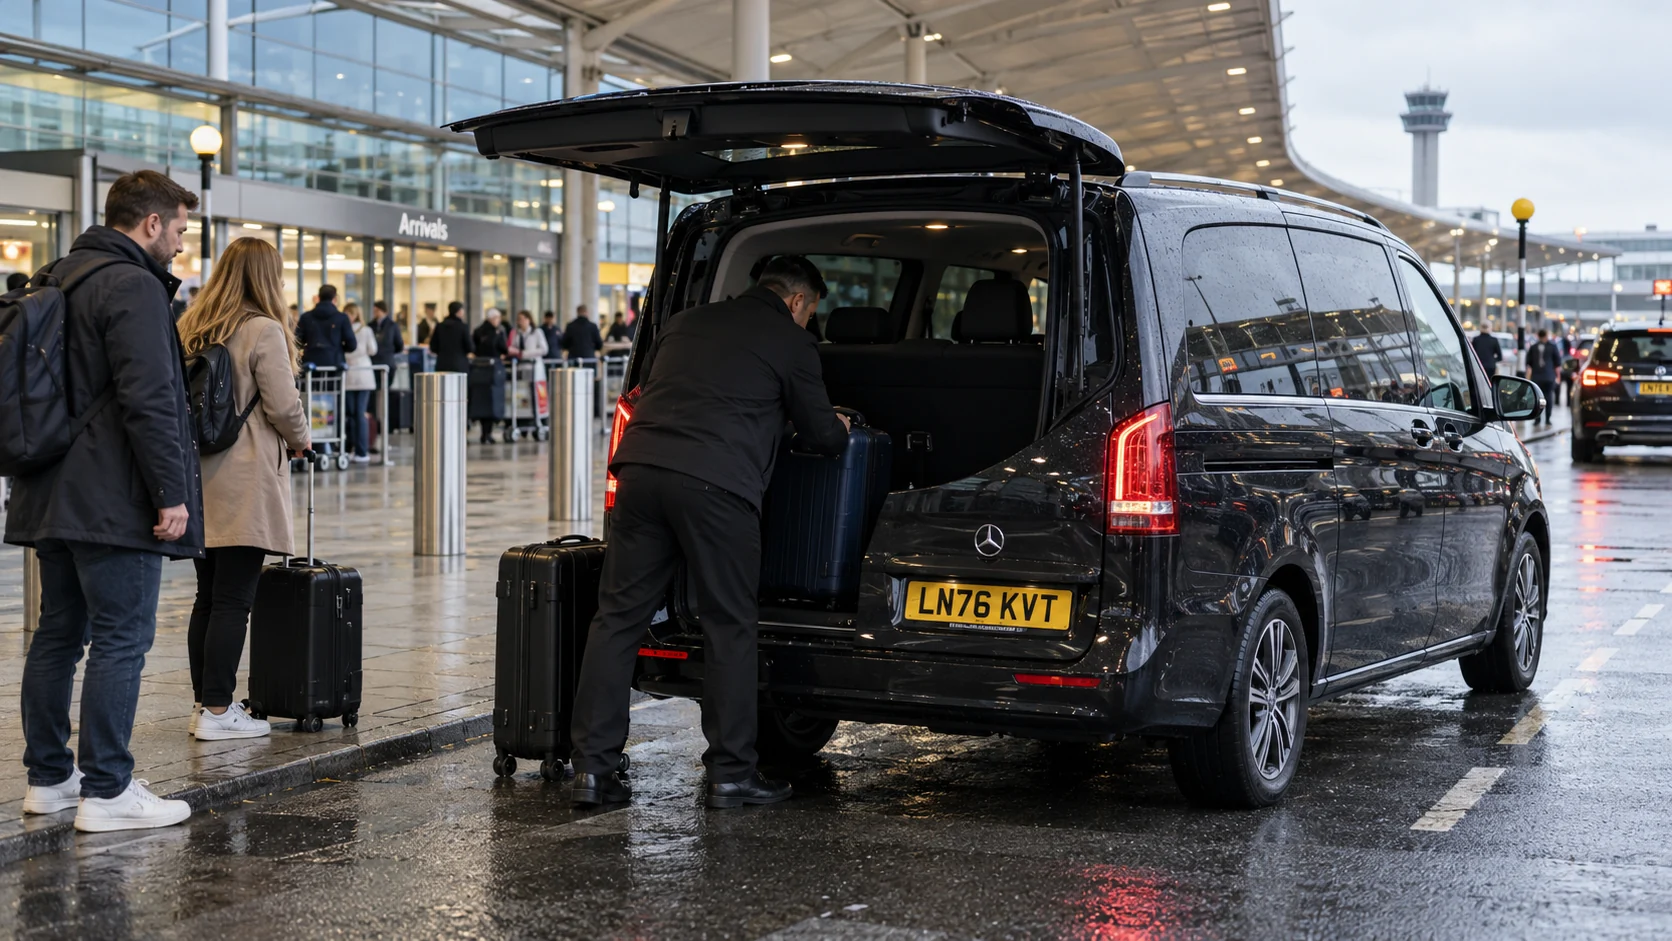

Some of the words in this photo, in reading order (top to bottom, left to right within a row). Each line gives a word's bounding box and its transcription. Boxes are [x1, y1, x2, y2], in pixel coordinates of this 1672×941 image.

[399, 212, 448, 241] Arrivals
[918, 586, 991, 618] LN76
[1000, 591, 1058, 623] KVT
